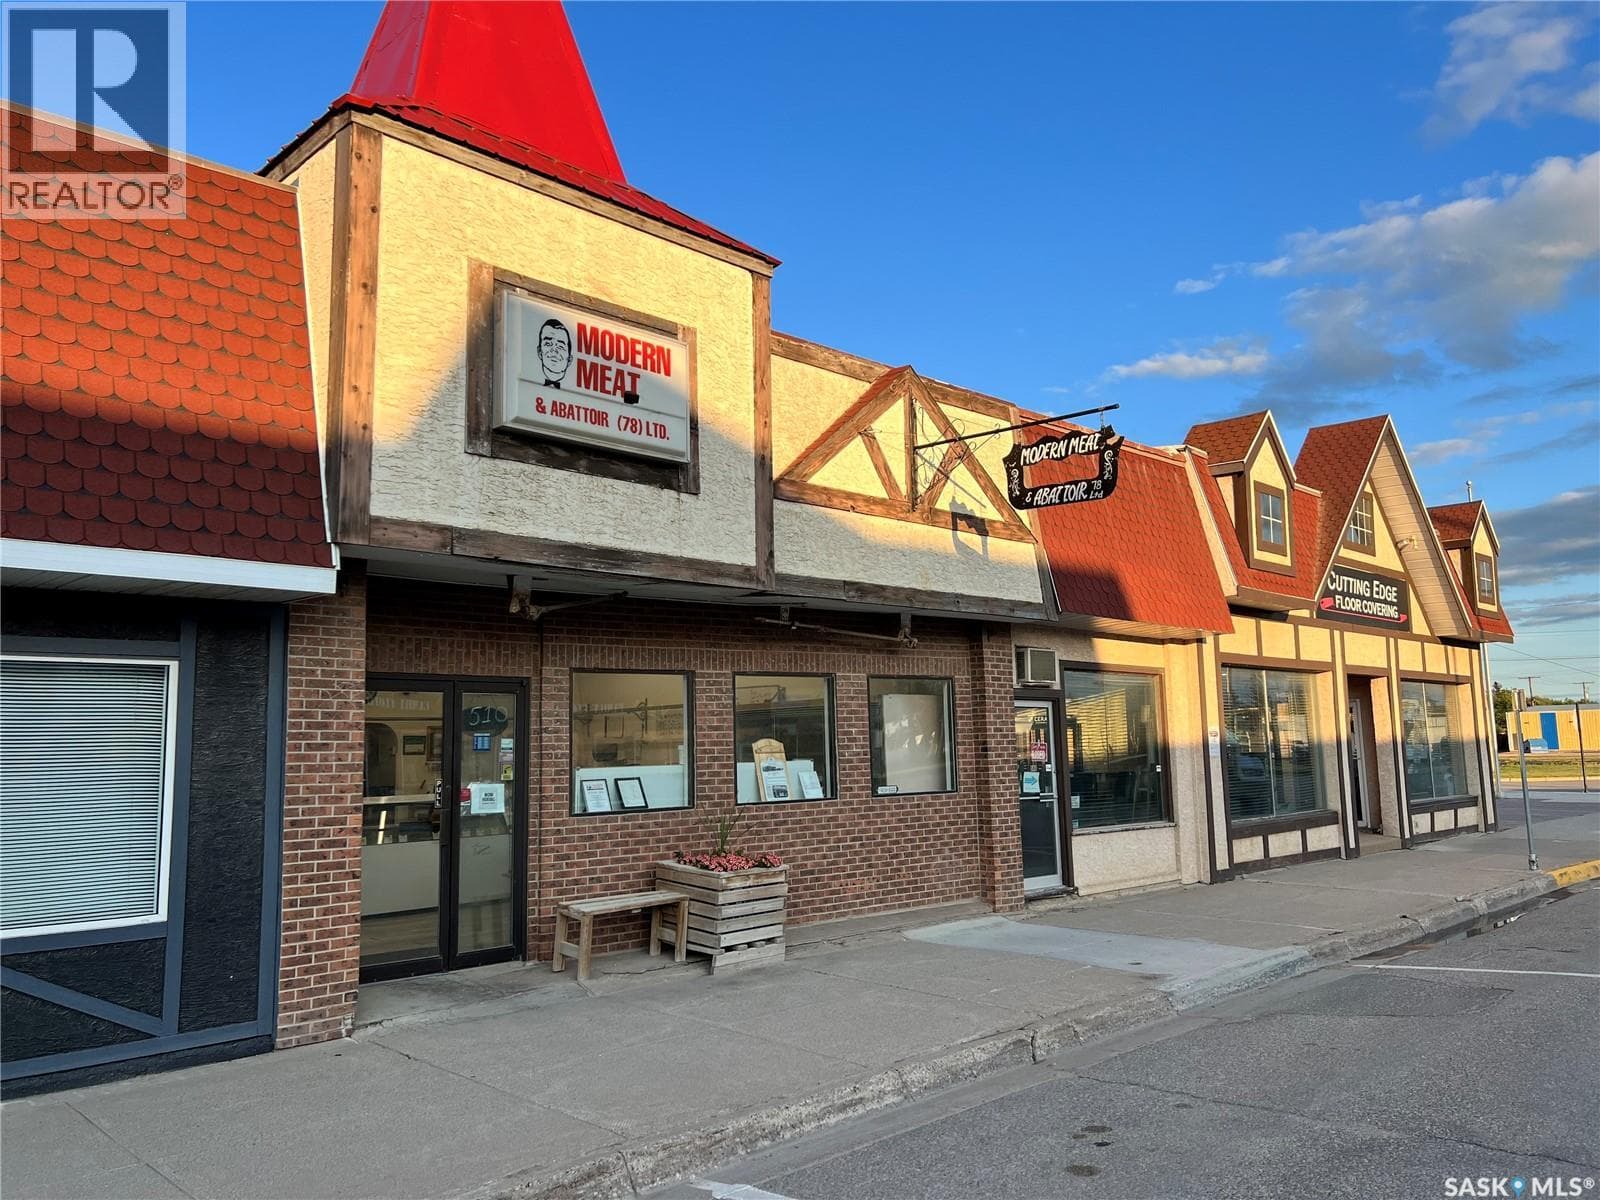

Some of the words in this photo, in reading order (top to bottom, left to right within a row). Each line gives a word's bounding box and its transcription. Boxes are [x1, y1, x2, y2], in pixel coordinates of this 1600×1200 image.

[576, 322, 671, 377] MODERN
[576, 359, 641, 399] MEAT
[535, 396, 547, 415] &
[550, 400, 609, 428] ABATTOIR
[617, 414, 643, 436] (78)
[645, 421, 670, 441] LTD.
[1020, 439, 1068, 466] MODERN
[1068, 433, 1102, 456] MEAT
[1327, 570, 1370, 597] CUTTING
[1373, 580, 1398, 602] EDGE
[1335, 595, 1362, 613] FLOOR
[1362, 600, 1399, 619] COVERING
[469, 706, 508, 727] 510
